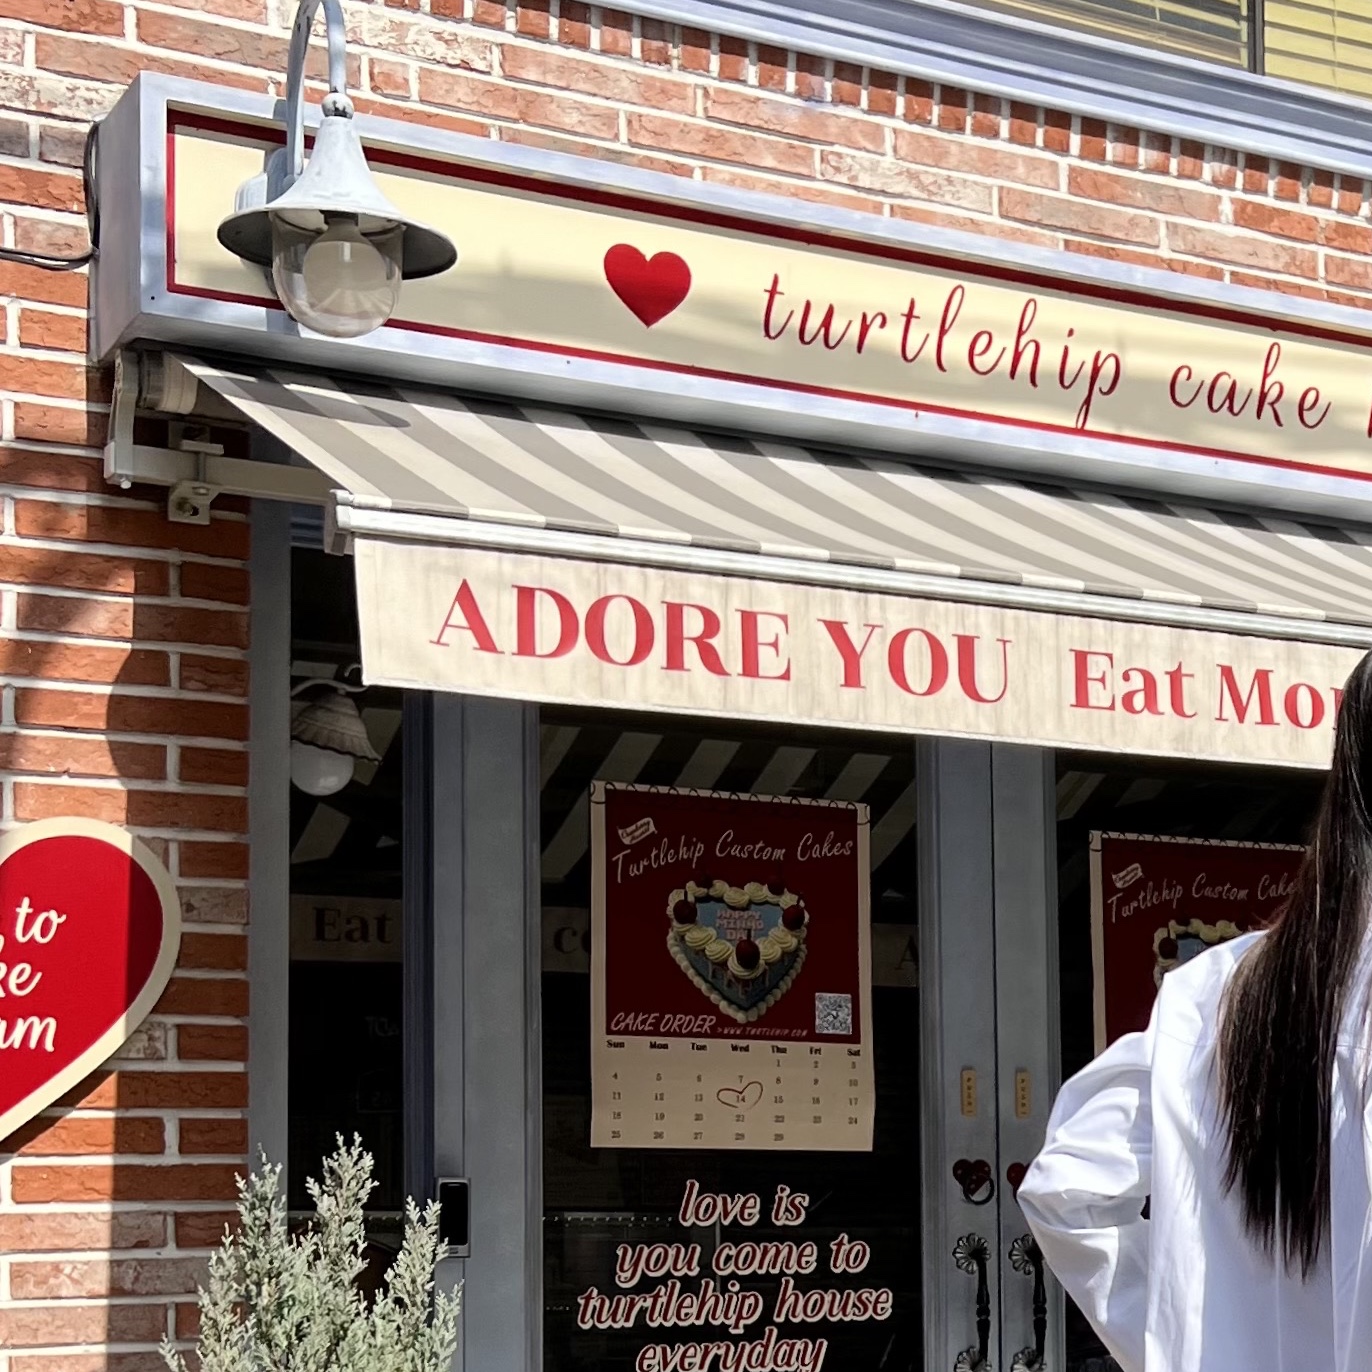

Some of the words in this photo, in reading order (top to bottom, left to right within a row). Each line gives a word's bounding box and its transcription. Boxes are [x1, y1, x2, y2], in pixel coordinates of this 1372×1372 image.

[763, 273, 1121, 430] turtlehip
[1169, 342, 1331, 429] cake
[429, 578, 792, 681] ADORE
[817, 618, 1013, 704] YOU
[1069, 648, 1198, 718] Eat
[611, 834, 705, 884] Turtlehip
[715, 829, 786, 862] Custom
[796, 830, 854, 862] Cakes
[15, 896, 67, 944] to
[1107, 878, 1184, 924] Turtlehip
[1192, 872, 1249, 901] Custom
[1257, 871, 1297, 901] Cake
[312, 906, 394, 944] Eat
[607, 1040, 625, 1048] Sun
[649, 1041, 668, 1049] Mon
[692, 1043, 707, 1051] Tue
[731, 1044, 749, 1052] Wed
[610, 1012, 659, 1033] CAKE
[659, 1014, 717, 1035] ORDER
[737, 1075, 744, 1083] 7
[776, 1059, 781, 1067] 1
[848, 1097, 859, 1105] 17
[678, 1179, 760, 1227] love
[771, 1184, 810, 1227] is
[615, 1243, 701, 1288] you
[711, 1241, 817, 1276] come
[830, 1233, 871, 1274] to
[577, 1278, 763, 1335] turtlehip
[773, 1276, 893, 1323] house
